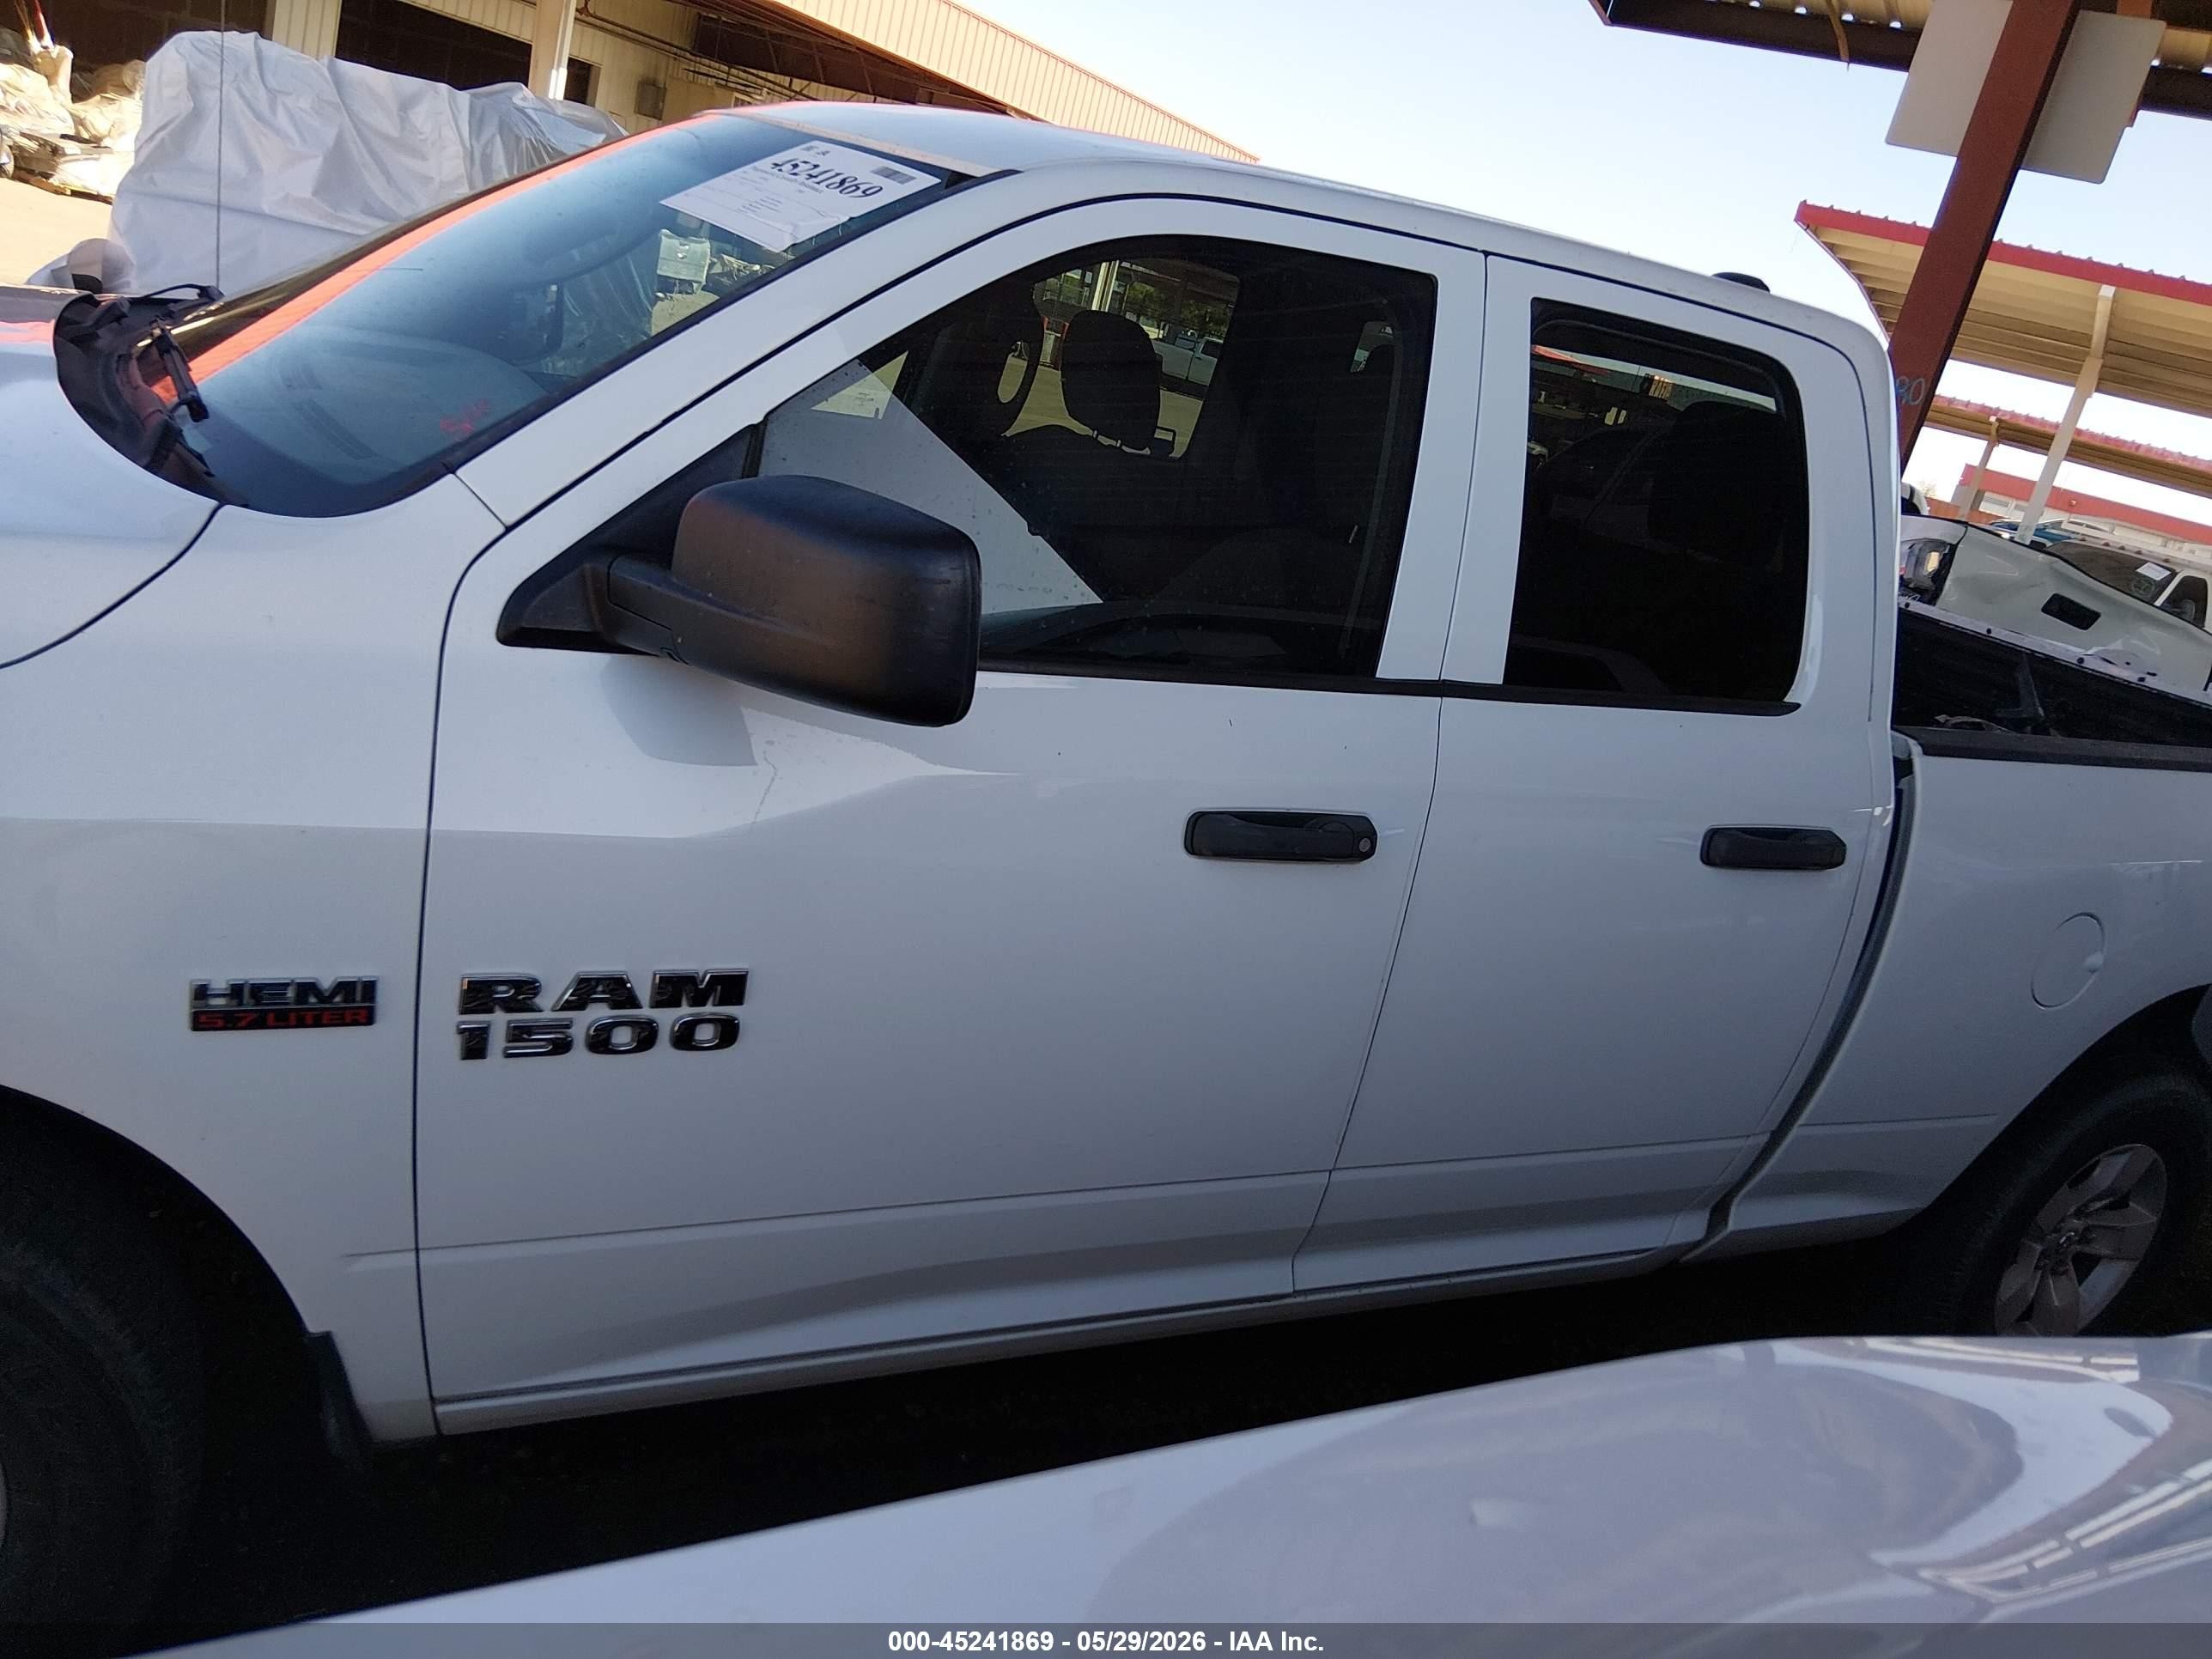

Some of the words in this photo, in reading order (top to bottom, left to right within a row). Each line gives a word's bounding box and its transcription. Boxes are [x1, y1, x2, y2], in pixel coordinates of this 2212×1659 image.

[770, 157, 884, 198] 45241869
[190, 976, 378, 1011] HEMI
[459, 969, 750, 1015] RAM
[197, 1012, 258, 1029] 5.7
[265, 1007, 369, 1026] LITER
[456, 1012, 741, 1061] 1500
